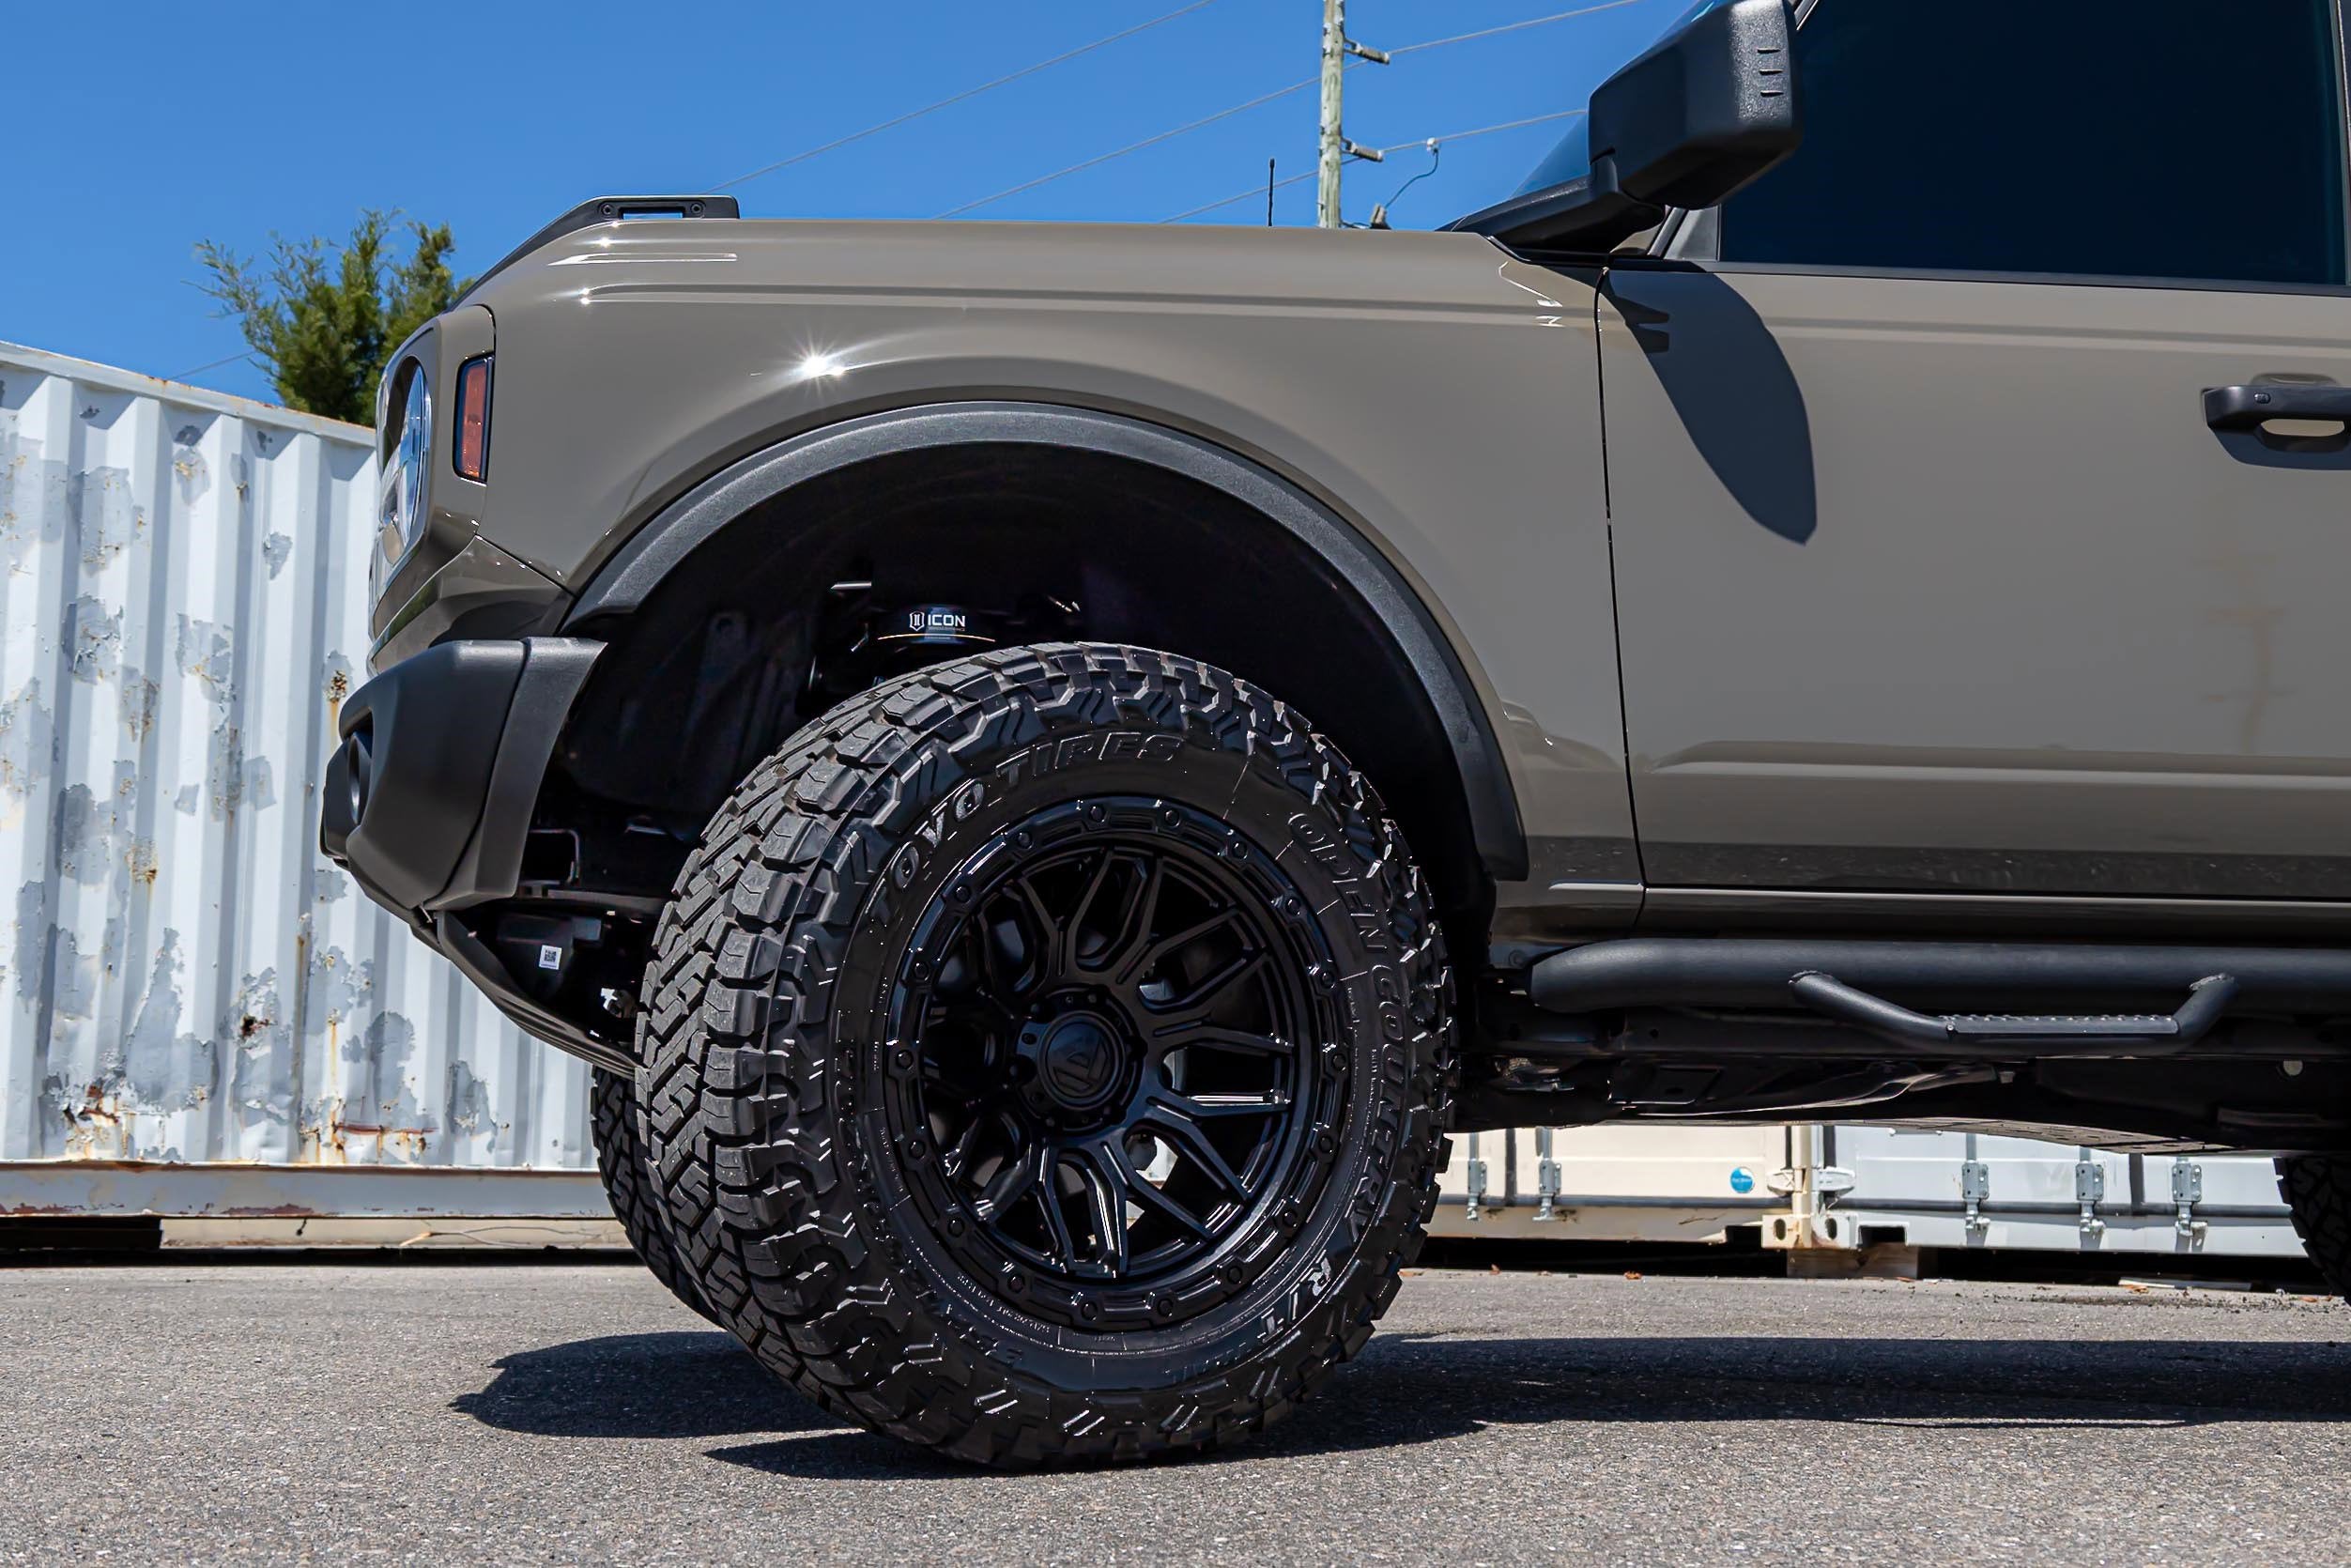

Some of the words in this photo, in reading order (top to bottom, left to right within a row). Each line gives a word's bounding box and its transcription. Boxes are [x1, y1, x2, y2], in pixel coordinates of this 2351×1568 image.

[928, 614, 965, 627] ICON
[864, 777, 985, 930] TOYO
[1257, 1249, 1331, 1344] R/T
